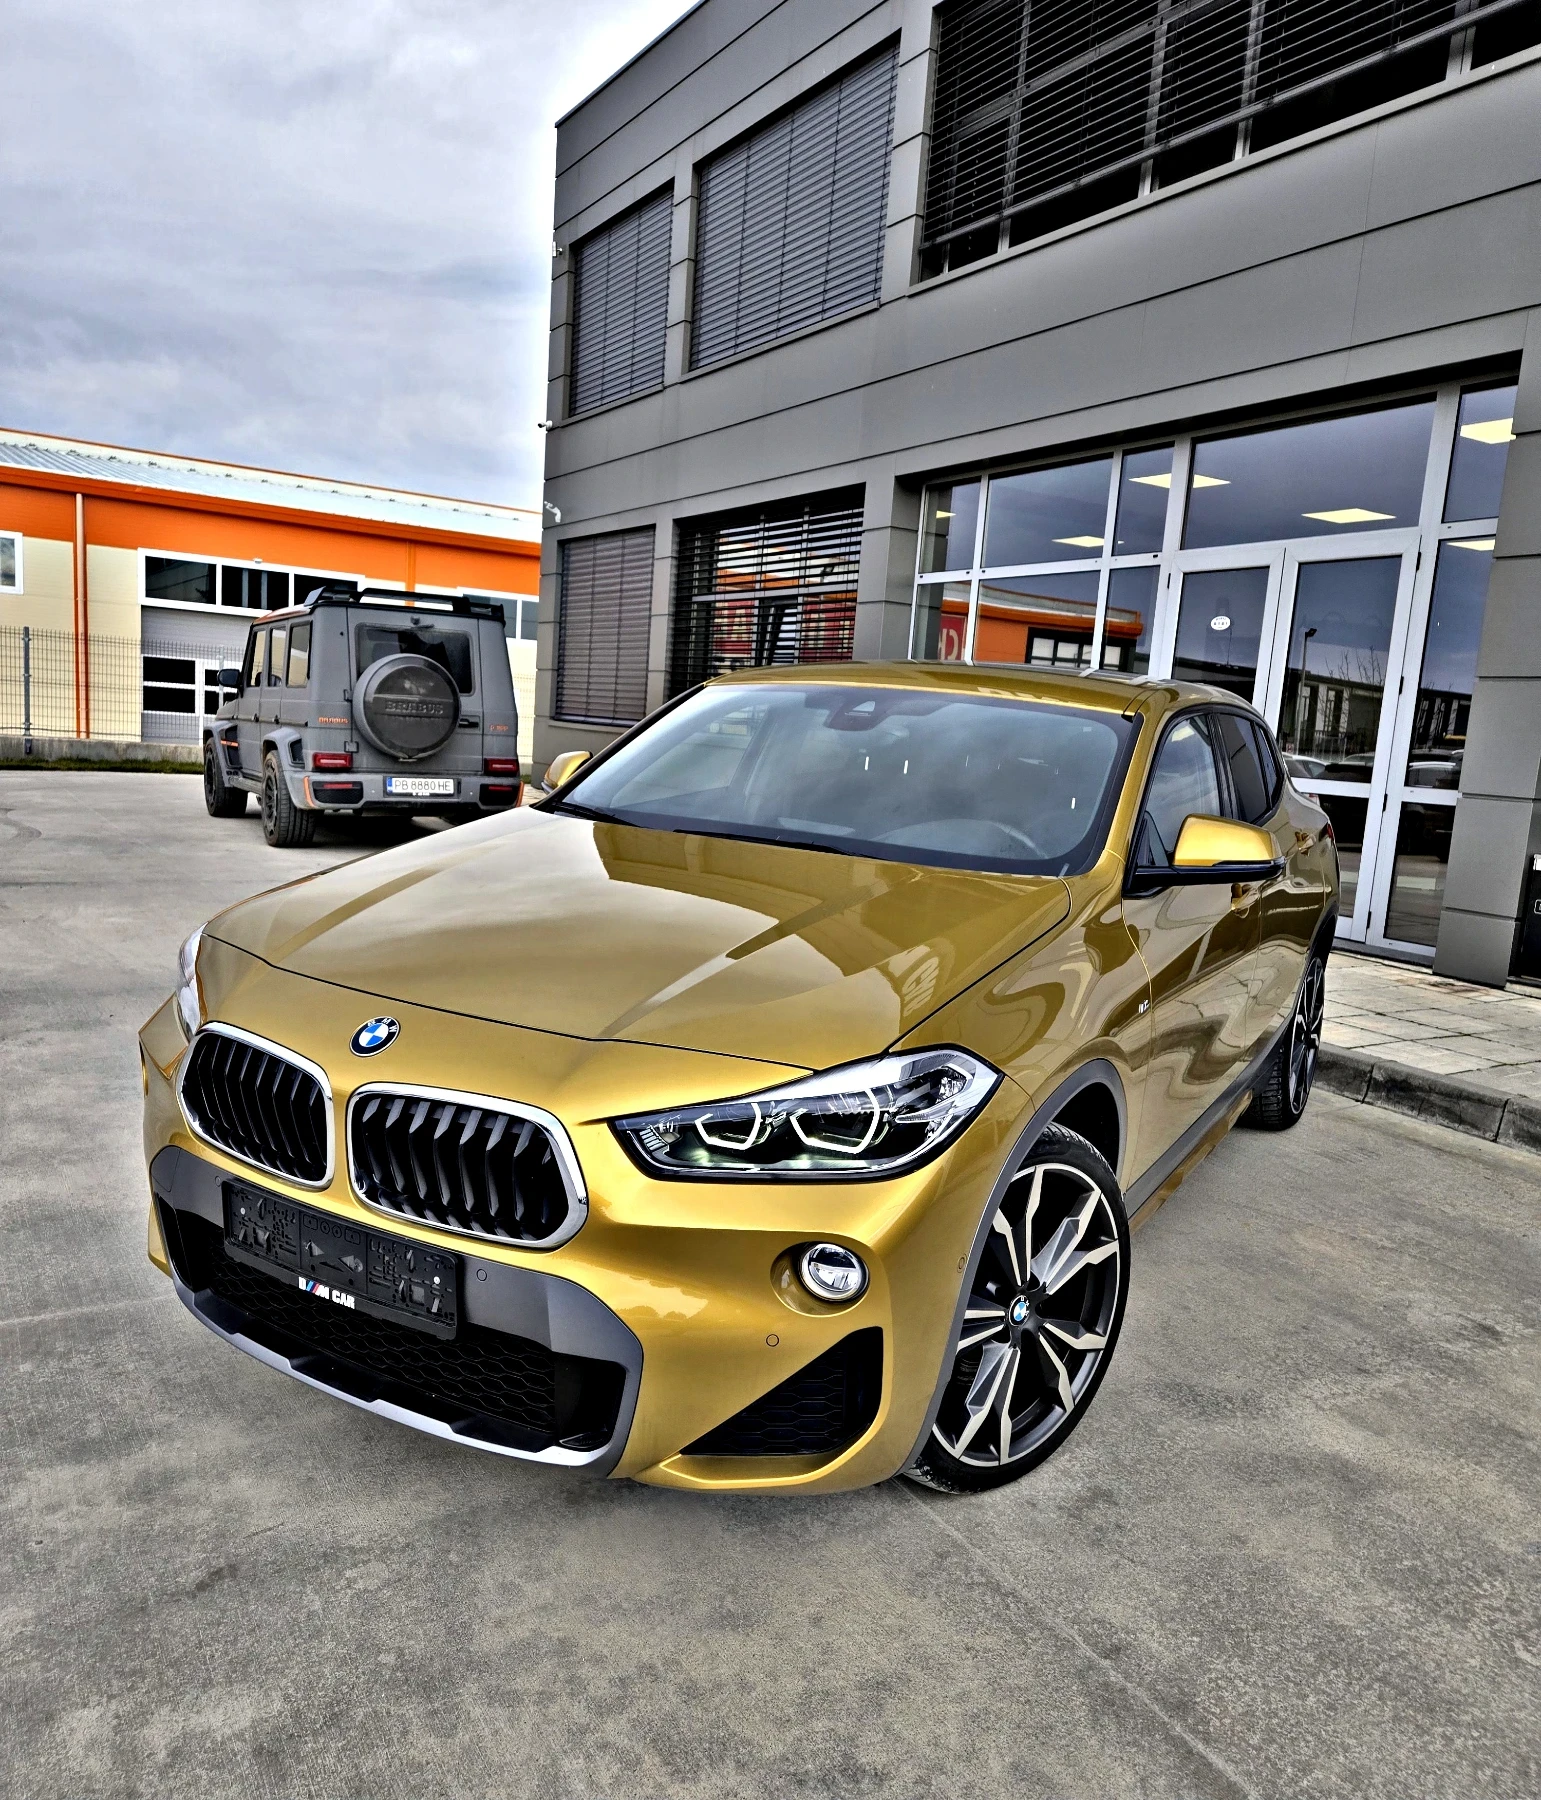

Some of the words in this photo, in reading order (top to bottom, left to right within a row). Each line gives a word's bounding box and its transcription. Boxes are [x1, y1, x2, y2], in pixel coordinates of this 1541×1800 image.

[385, 701, 444, 715] BRABUS
[394, 779, 409, 791] PB
[410, 780, 436, 791] 8880
[438, 780, 452, 792] HE
[367, 1018, 398, 1033] BMW
[331, 1289, 355, 1310] CAR
